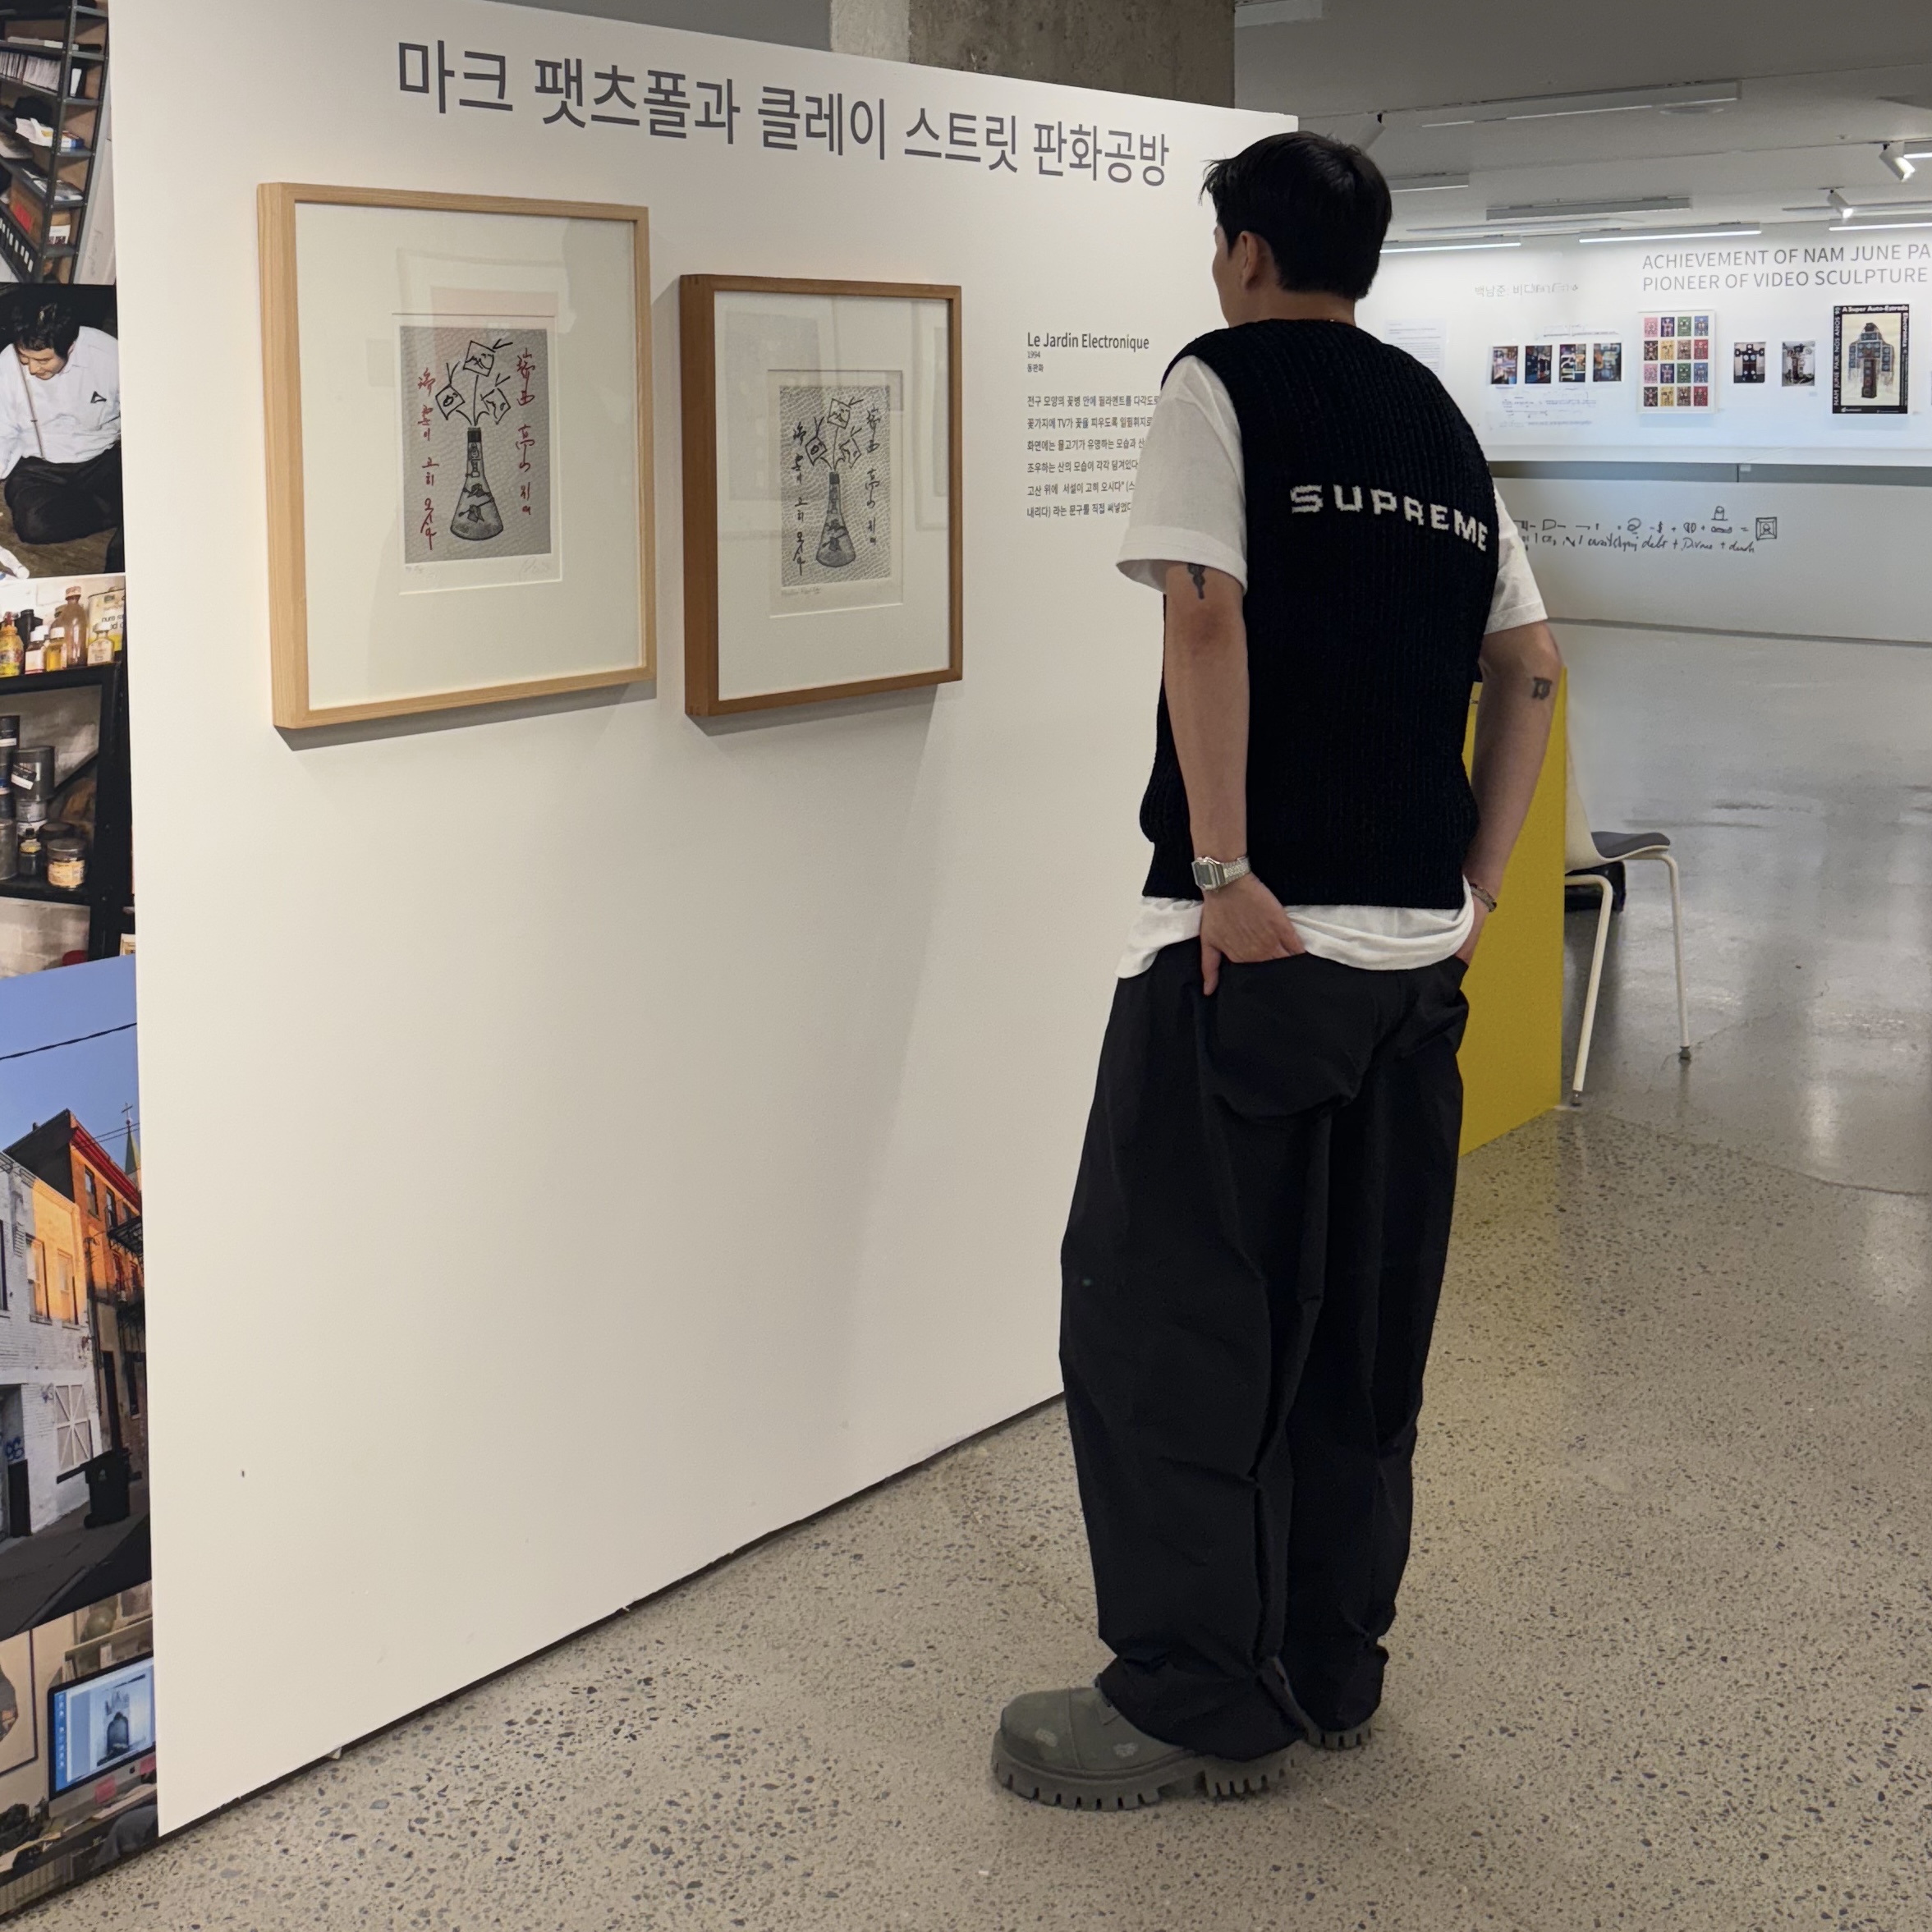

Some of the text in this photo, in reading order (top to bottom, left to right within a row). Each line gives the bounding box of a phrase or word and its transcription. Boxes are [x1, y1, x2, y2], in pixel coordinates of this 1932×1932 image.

[399, 40, 1170, 187] 마크 팻츠폴과 클레이 스트릿 판화공방
[1643, 250, 1769, 270] ACHIEVEMENT
[1774, 249, 1798, 264] OF
[1804, 247, 1844, 264] NAM
[1851, 244, 1901, 262] JUNE
[1643, 267, 1928, 291] PIONEER OF VIDEO SCULPTURE
[1027, 332, 1149, 352] Le Jardin Electronique
[1027, 351, 1040, 359] 1994
[1027, 396, 1042, 407] 전구
[1044, 396, 1065, 407] 모양의
[1067, 396, 1081, 407] 꽃병
[1058, 419, 1073, 429] TV가
[1091, 417, 1117, 429] 피우도록
[1058, 439, 1085, 451] 물고기가
[1096, 460, 1109, 470] 각각
[1027, 485, 1041, 497] 고산
[1044, 484, 1058, 495] 위에
[1053, 505, 1067, 516] 라는
[1289, 484, 1488, 552] SUPREME
